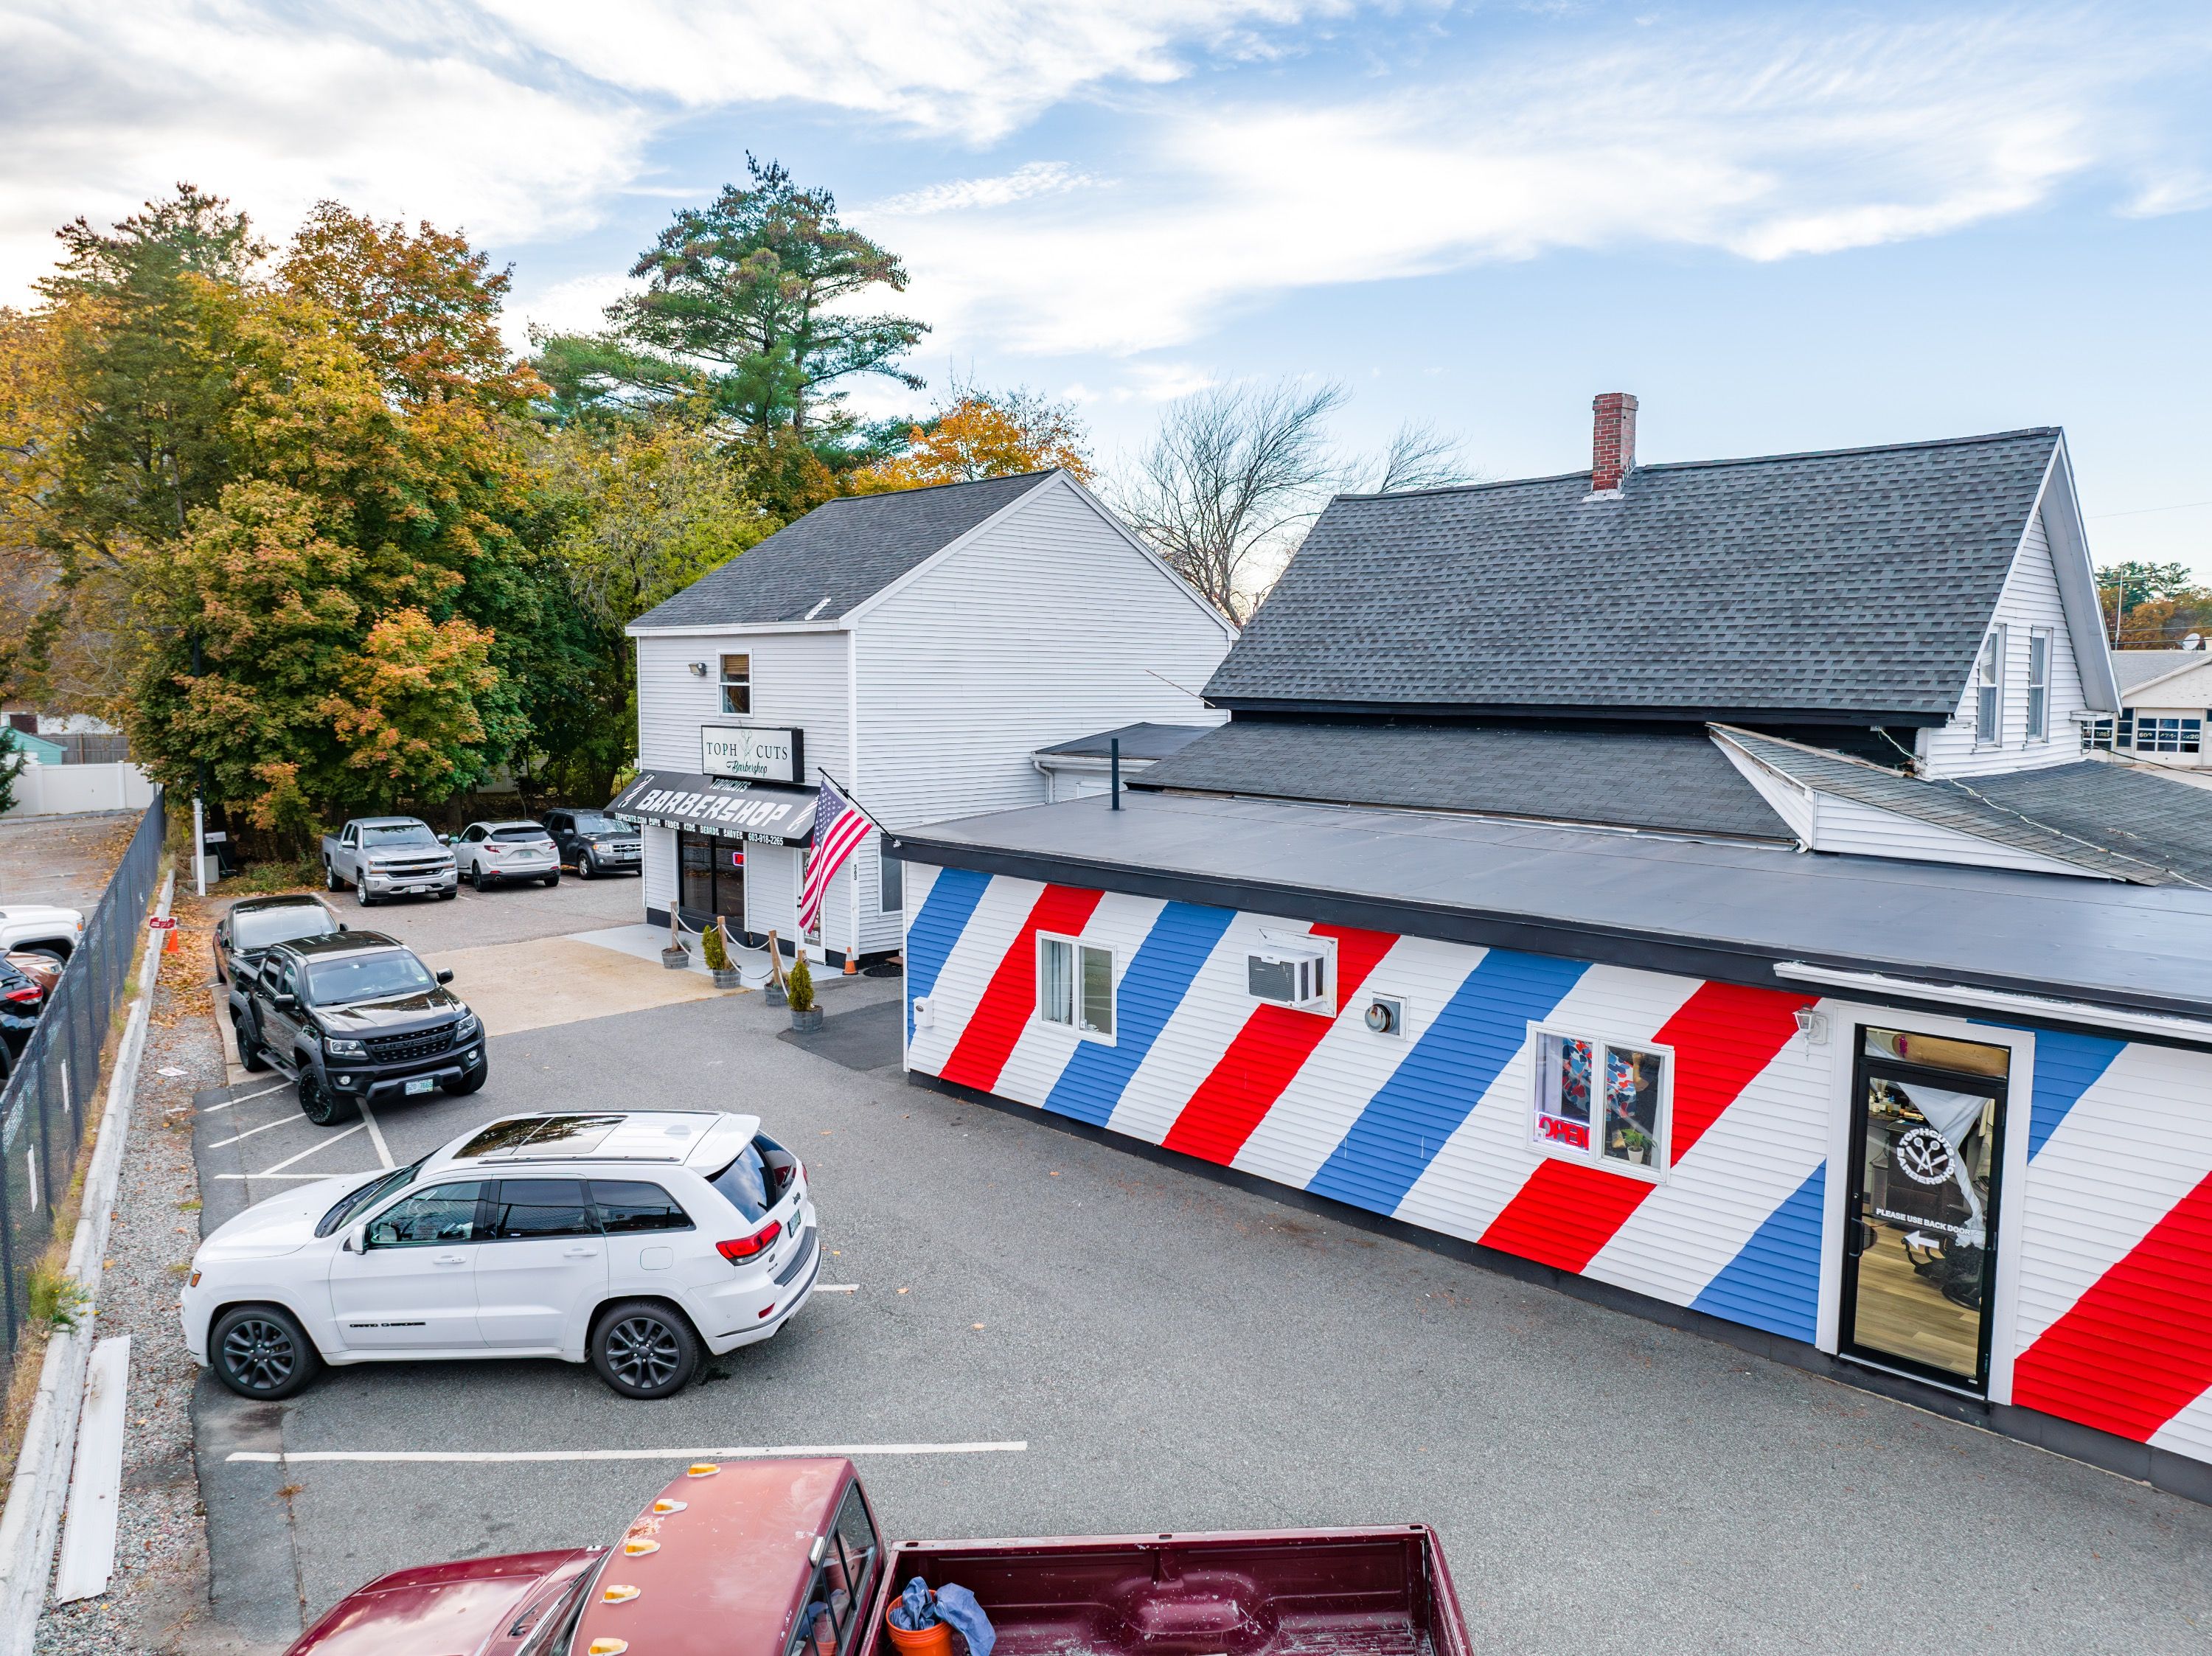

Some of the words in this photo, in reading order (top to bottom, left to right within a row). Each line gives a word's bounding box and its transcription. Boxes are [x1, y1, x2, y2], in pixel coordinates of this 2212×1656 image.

[706, 742, 737, 756] TOPH
[757, 745, 787, 760] CUTS
[726, 760, 768, 777] Barbershop
[709, 778, 752, 793] TOPHCUTS
[635, 789, 793, 827] BARBERSHOP
[614, 812, 647, 825] TOPHCUTS.COM
[649, 817, 661, 827] CUTS
[664, 819, 680, 830] FADES
[684, 822, 696, 832] KIDS
[700, 825, 720, 836] BEARDS
[723, 829, 743, 840] SHAVES
[748, 832, 784, 846] 603-918-2265
[1538, 1116, 1590, 1149] OPEN
[1899, 1127, 1955, 1156] TOPHCUTS
[1896, 1147, 1956, 1185] BARBERSHOP
[1876, 1208, 1907, 1221] PLEASE
[1907, 1214, 1924, 1225] USE
[1924, 1219, 1947, 1231] BACK
[1947, 1224, 1972, 1236] DOOR
